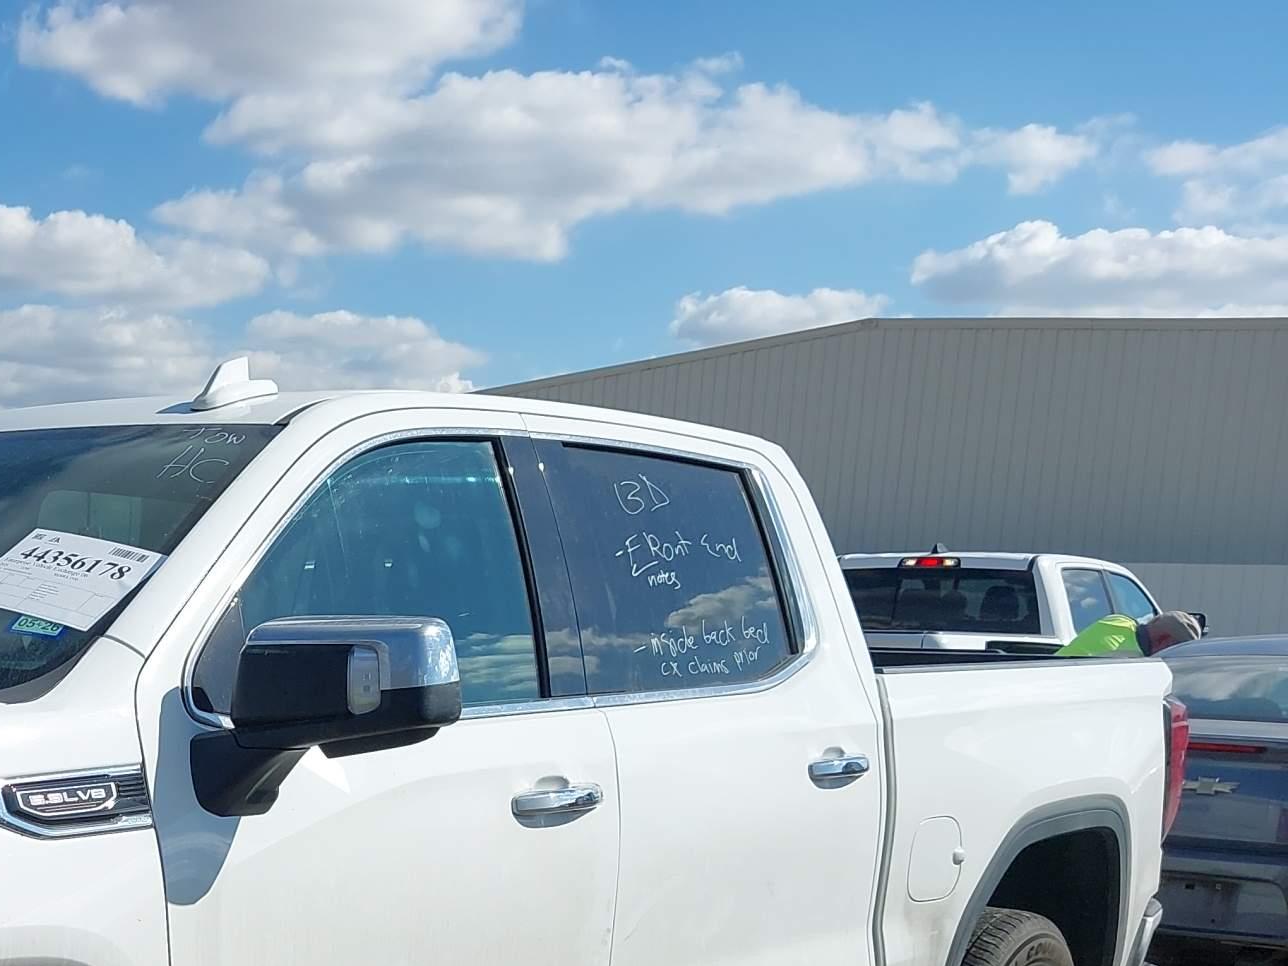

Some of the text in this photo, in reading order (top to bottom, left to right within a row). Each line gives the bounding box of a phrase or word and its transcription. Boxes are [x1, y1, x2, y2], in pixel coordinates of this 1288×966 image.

[20, 546, 132, 581] 44356178
[702, 619, 736, 647] back
[741, 615, 770, 644] bed
